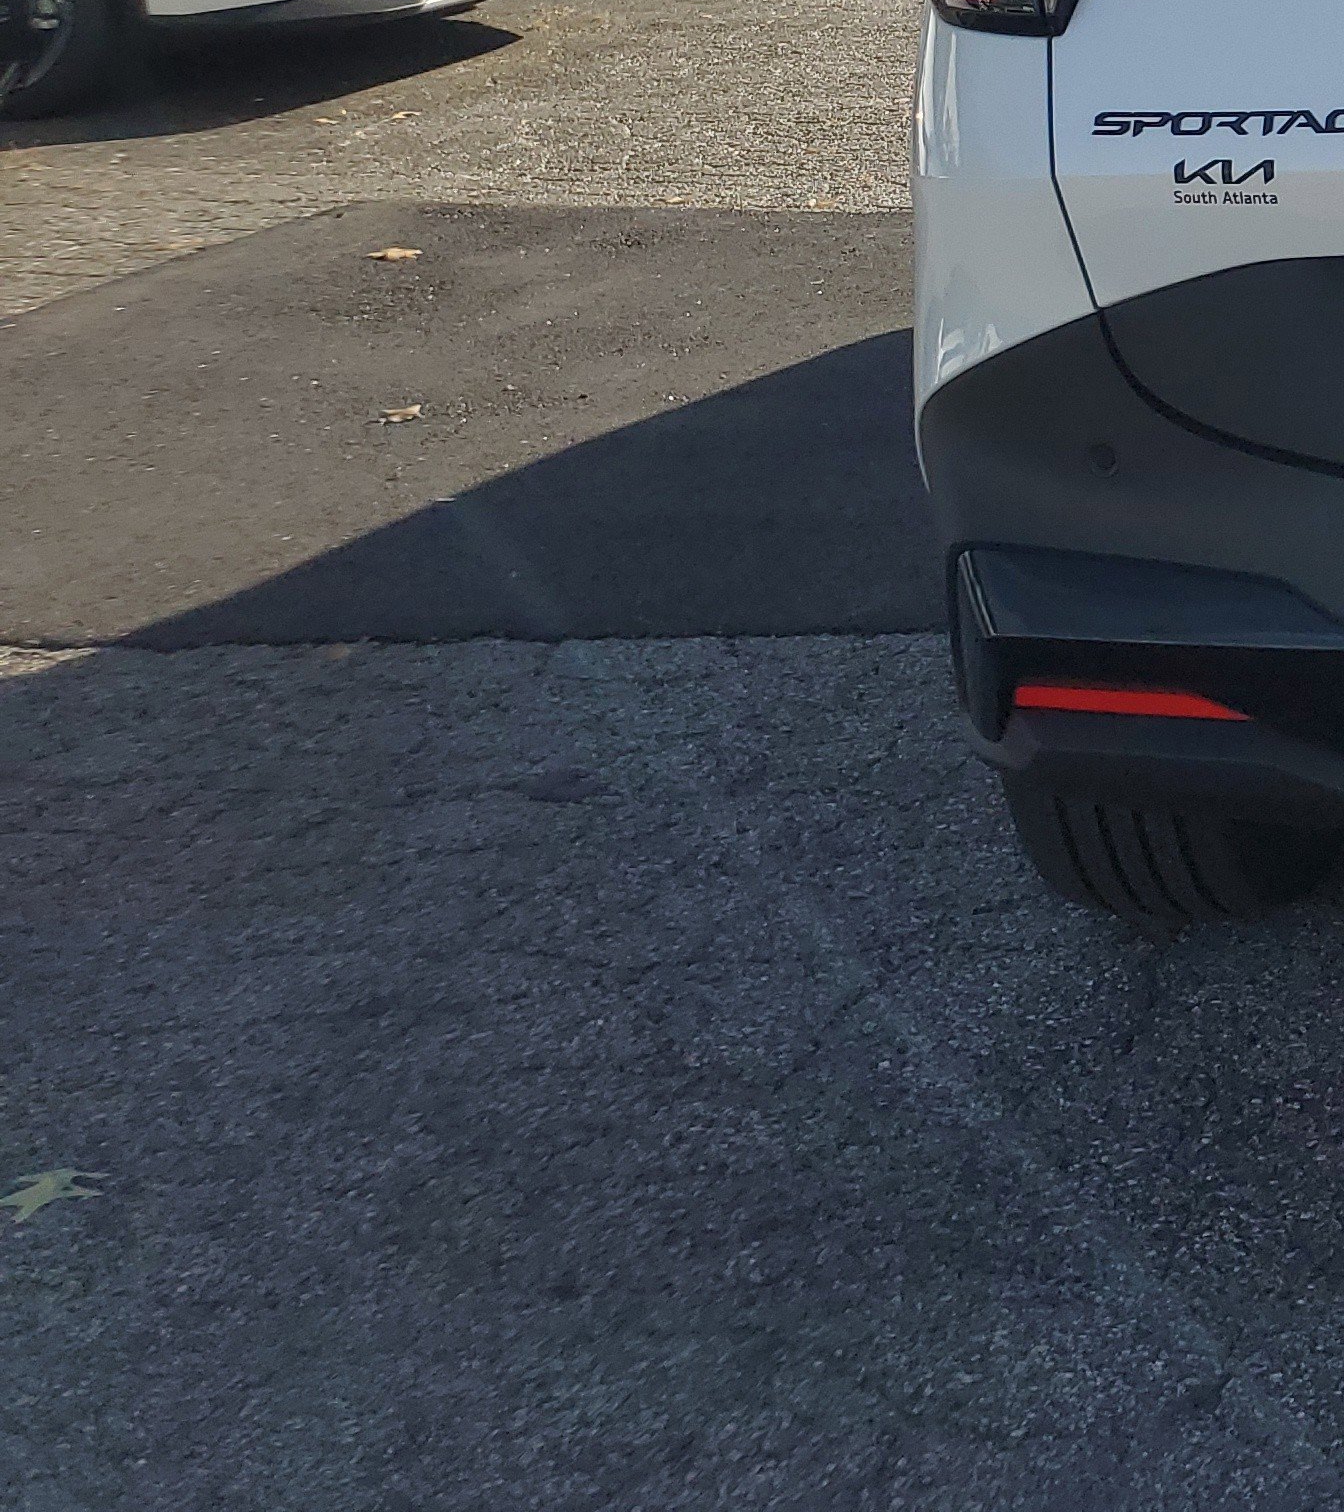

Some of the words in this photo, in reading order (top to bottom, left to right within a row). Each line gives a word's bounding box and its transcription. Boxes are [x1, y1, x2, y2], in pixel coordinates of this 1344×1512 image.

[1173, 159, 1275, 185] KIA
[1173, 190, 1218, 205] South
[1222, 190, 1279, 206] Atlanta
